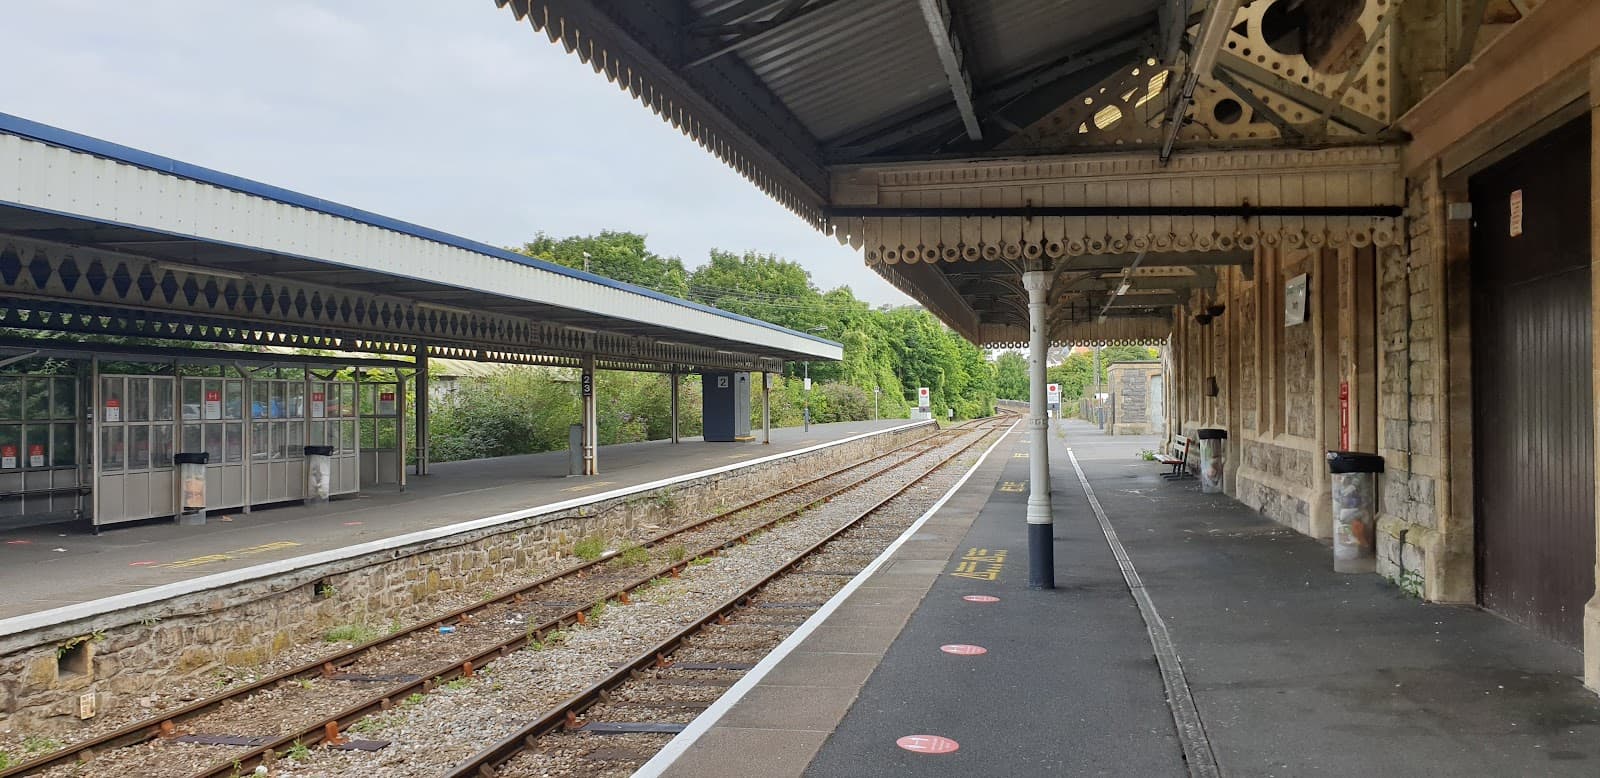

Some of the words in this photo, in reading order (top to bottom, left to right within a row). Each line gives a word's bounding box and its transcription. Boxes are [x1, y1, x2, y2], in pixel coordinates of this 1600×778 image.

[583, 375, 591, 384] 2
[720, 378, 726, 387] 2
[583, 384, 591, 393] 3
